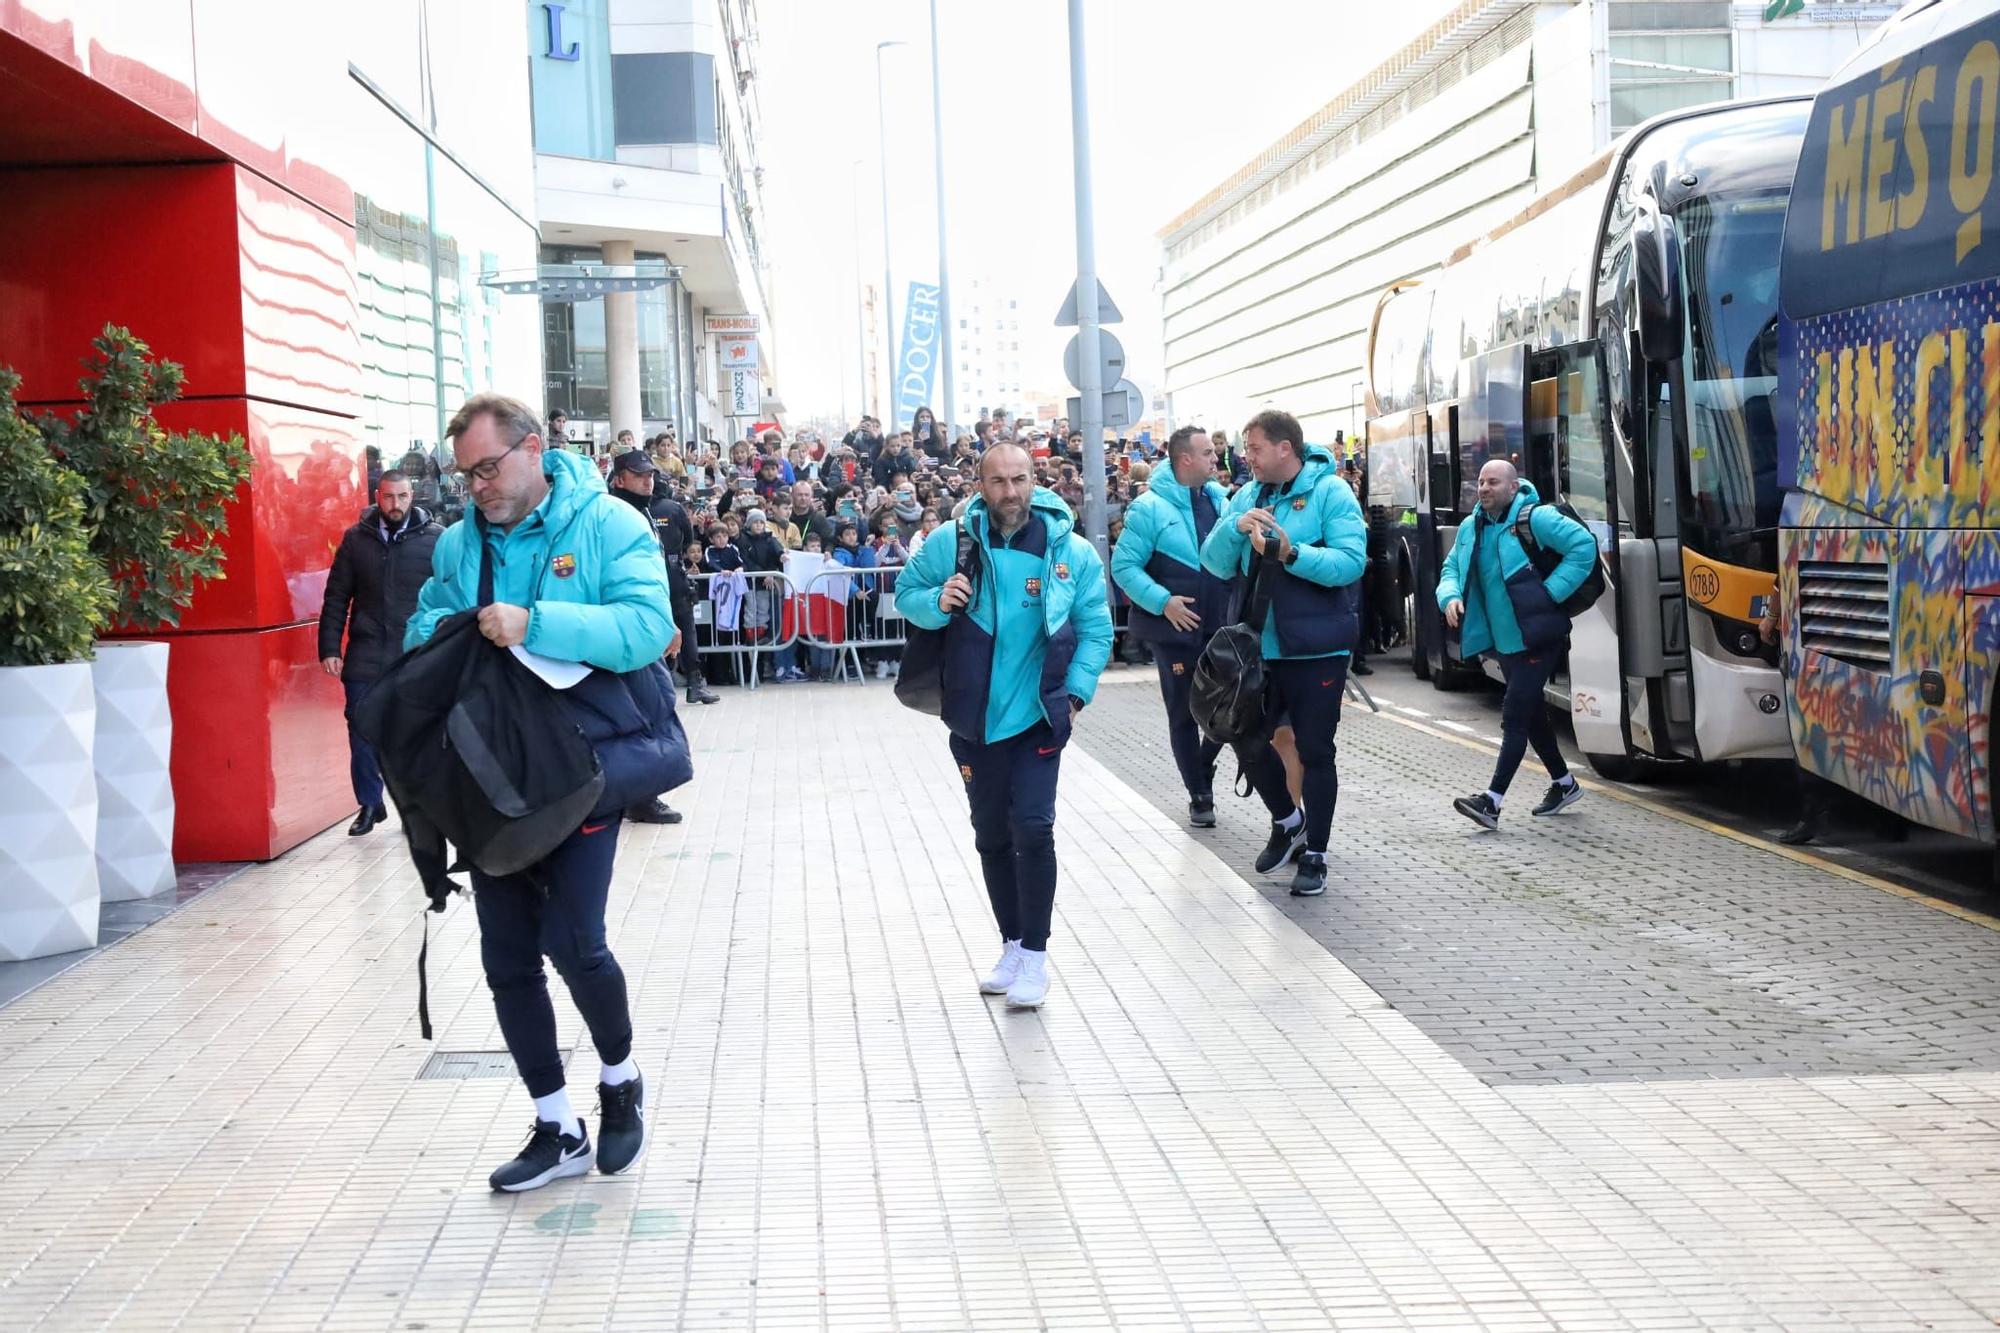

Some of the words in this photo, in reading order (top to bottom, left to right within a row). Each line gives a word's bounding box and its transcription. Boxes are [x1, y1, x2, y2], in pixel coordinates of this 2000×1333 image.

[1821, 57, 1937, 252] MÉS
[1949, 40, 2000, 267] Q
[1692, 573, 1715, 596] 2788
